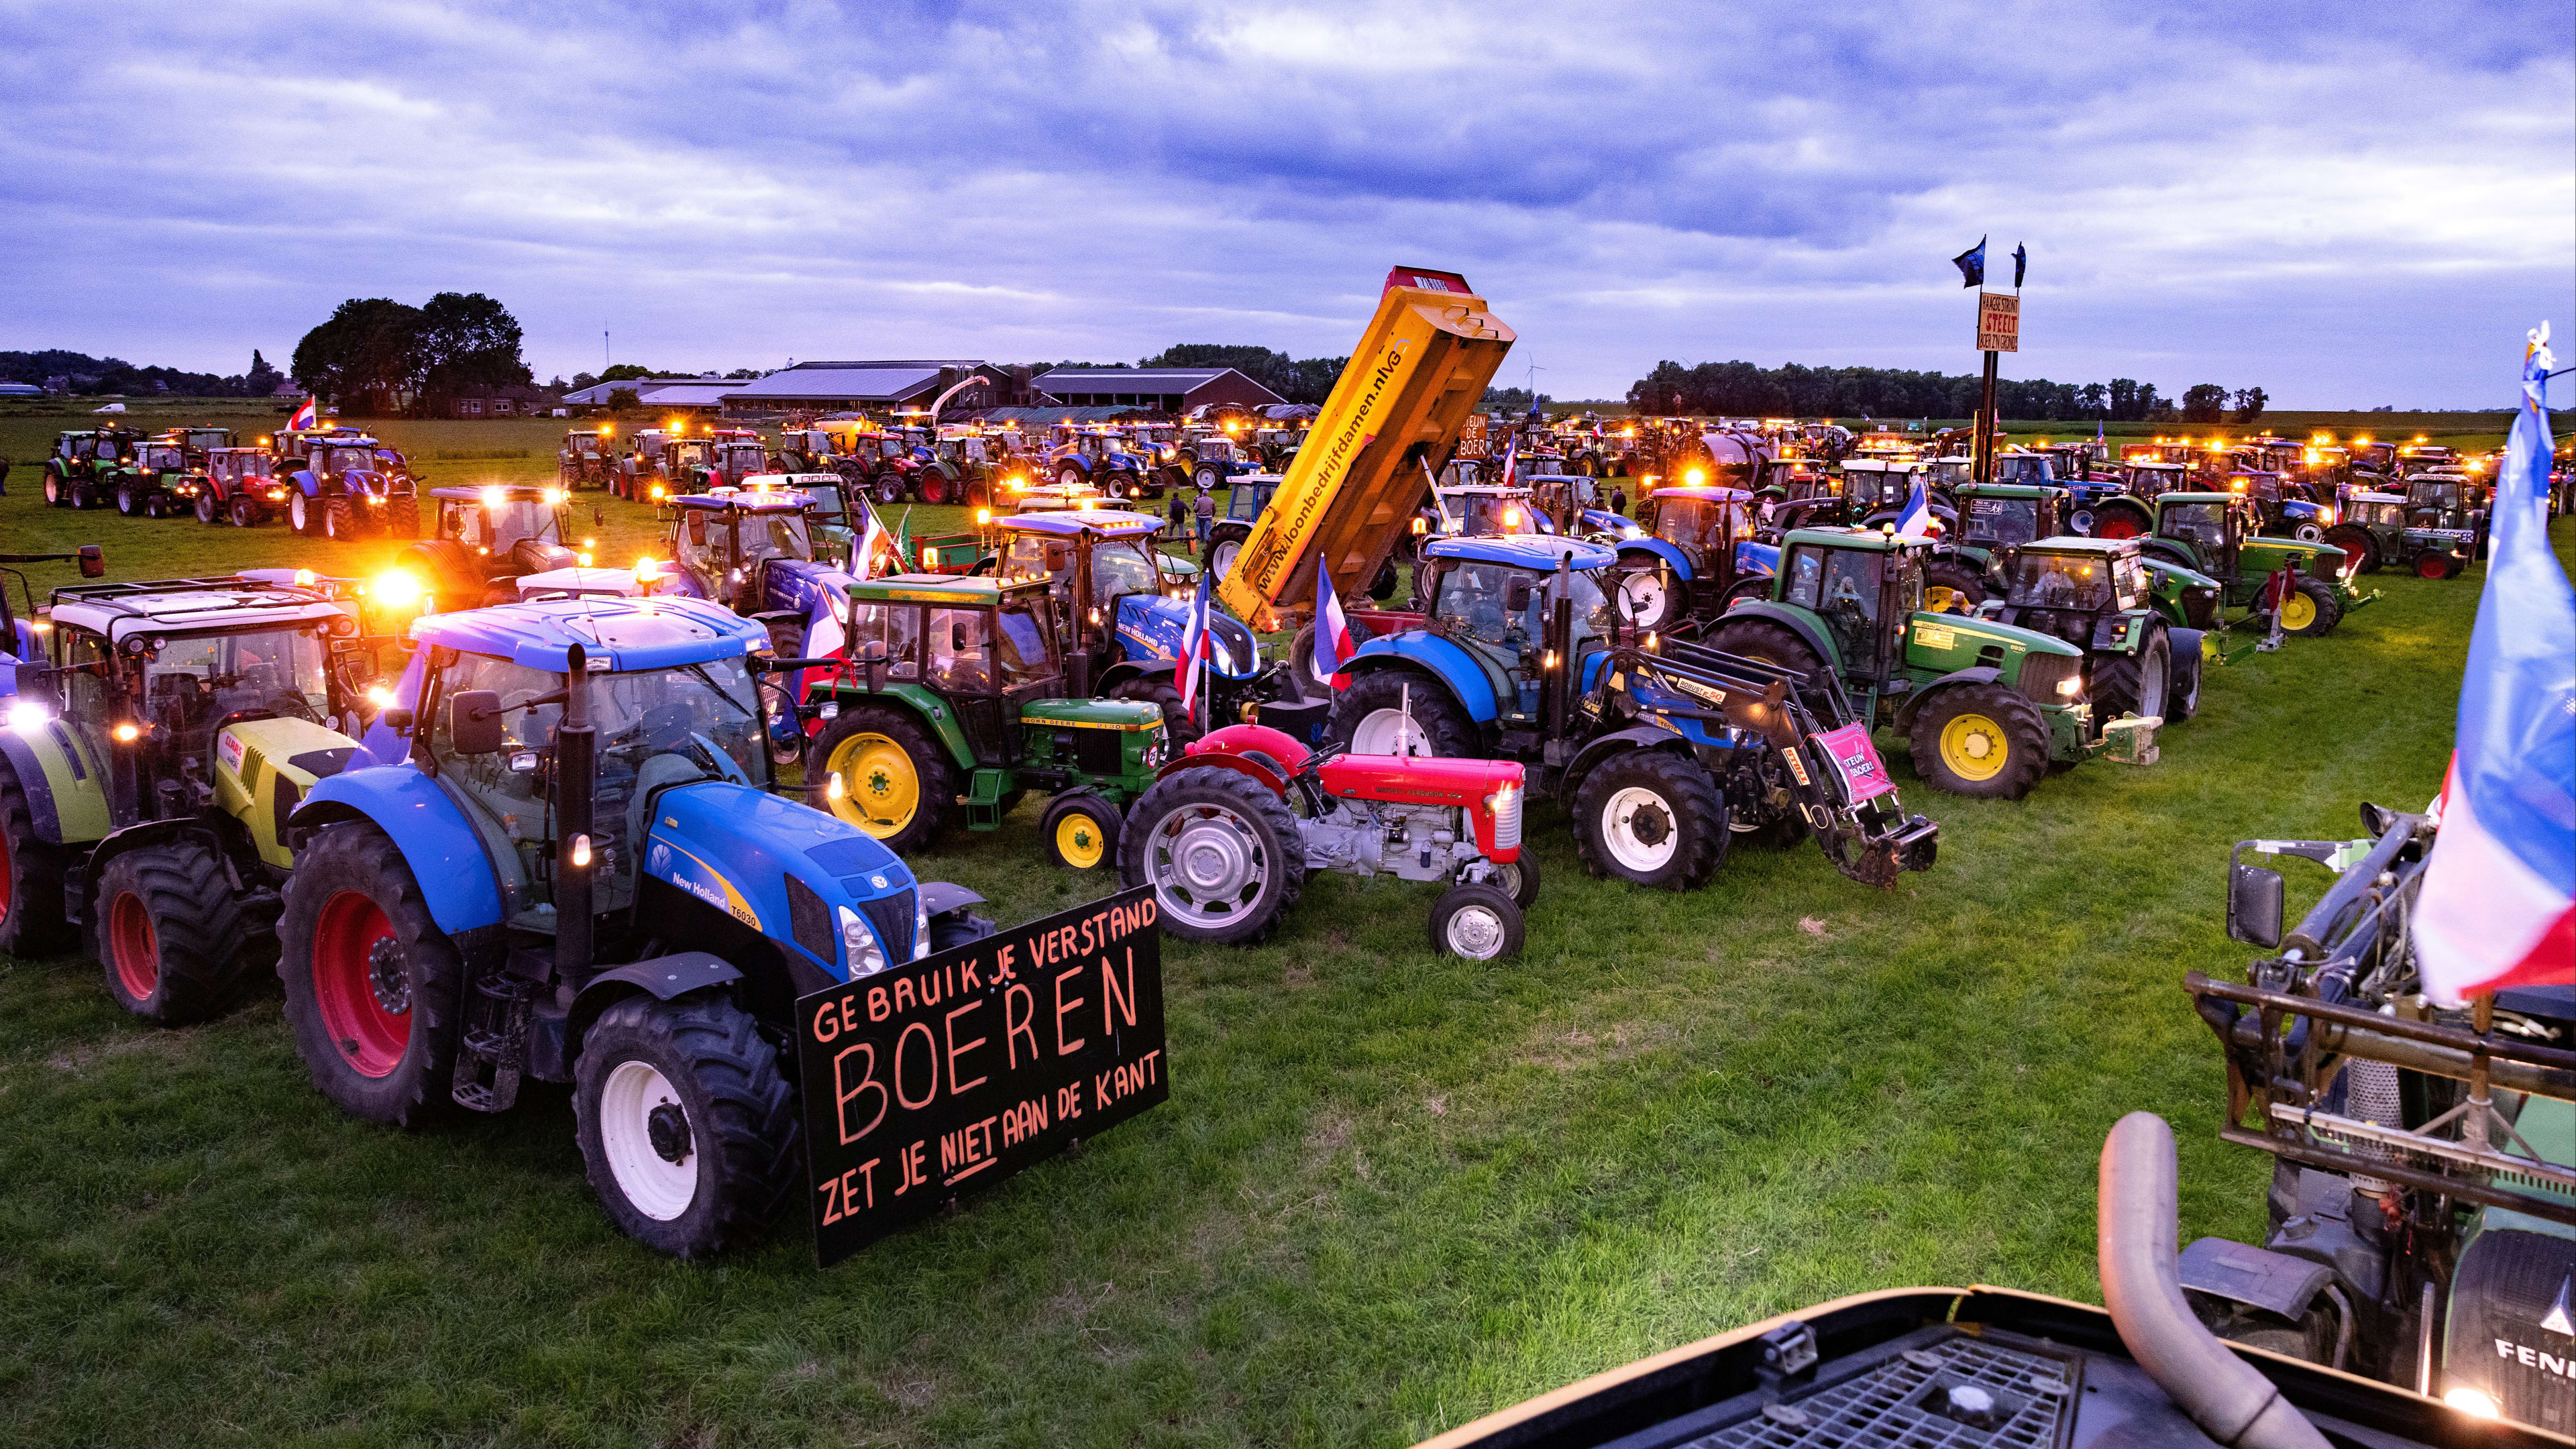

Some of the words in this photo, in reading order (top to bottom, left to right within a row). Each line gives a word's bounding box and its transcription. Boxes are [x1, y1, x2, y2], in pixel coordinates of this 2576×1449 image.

[1982, 295, 2000, 311] HAAGSE
[1986, 313, 2017, 333] STEELT
[1980, 333, 1991, 348] BOER
[1463, 415, 1485, 427] TEUN
[1526, 423, 1542, 432] JUDAS
[1466, 427, 1477, 439] DE
[1460, 439, 1486, 455] BOER
[1259, 369, 1389, 590] www.loonbedrijfdamen.nl
[1118, 622, 1131, 633] NEW
[1131, 628, 1159, 647] HOLLAND
[1680, 680, 1703, 693] ROBUST
[1637, 712, 1654, 724] land
[1660, 721, 1677, 732] T6070
[225, 735, 242, 757] CLAAS
[1150, 752, 1157, 762] 25
[1786, 749, 1806, 784] STOLL
[673, 872, 692, 890] New
[693, 881, 726, 908] Holland
[731, 905, 756, 926] T6030
[813, 959, 981, 1042] GEBRUIK
[989, 944, 1016, 985] JE
[1028, 898, 1157, 968] VERSTAND
[834, 946, 1136, 1146] BOEREN
[818, 1158, 880, 1226] ZET
[894, 1140, 927, 1197] JE
[941, 1116, 998, 1173] NIET
[1003, 1095, 1048, 1148] AAN
[1058, 1081, 1081, 1122] DE
[1095, 1049, 1161, 1110] KANT
